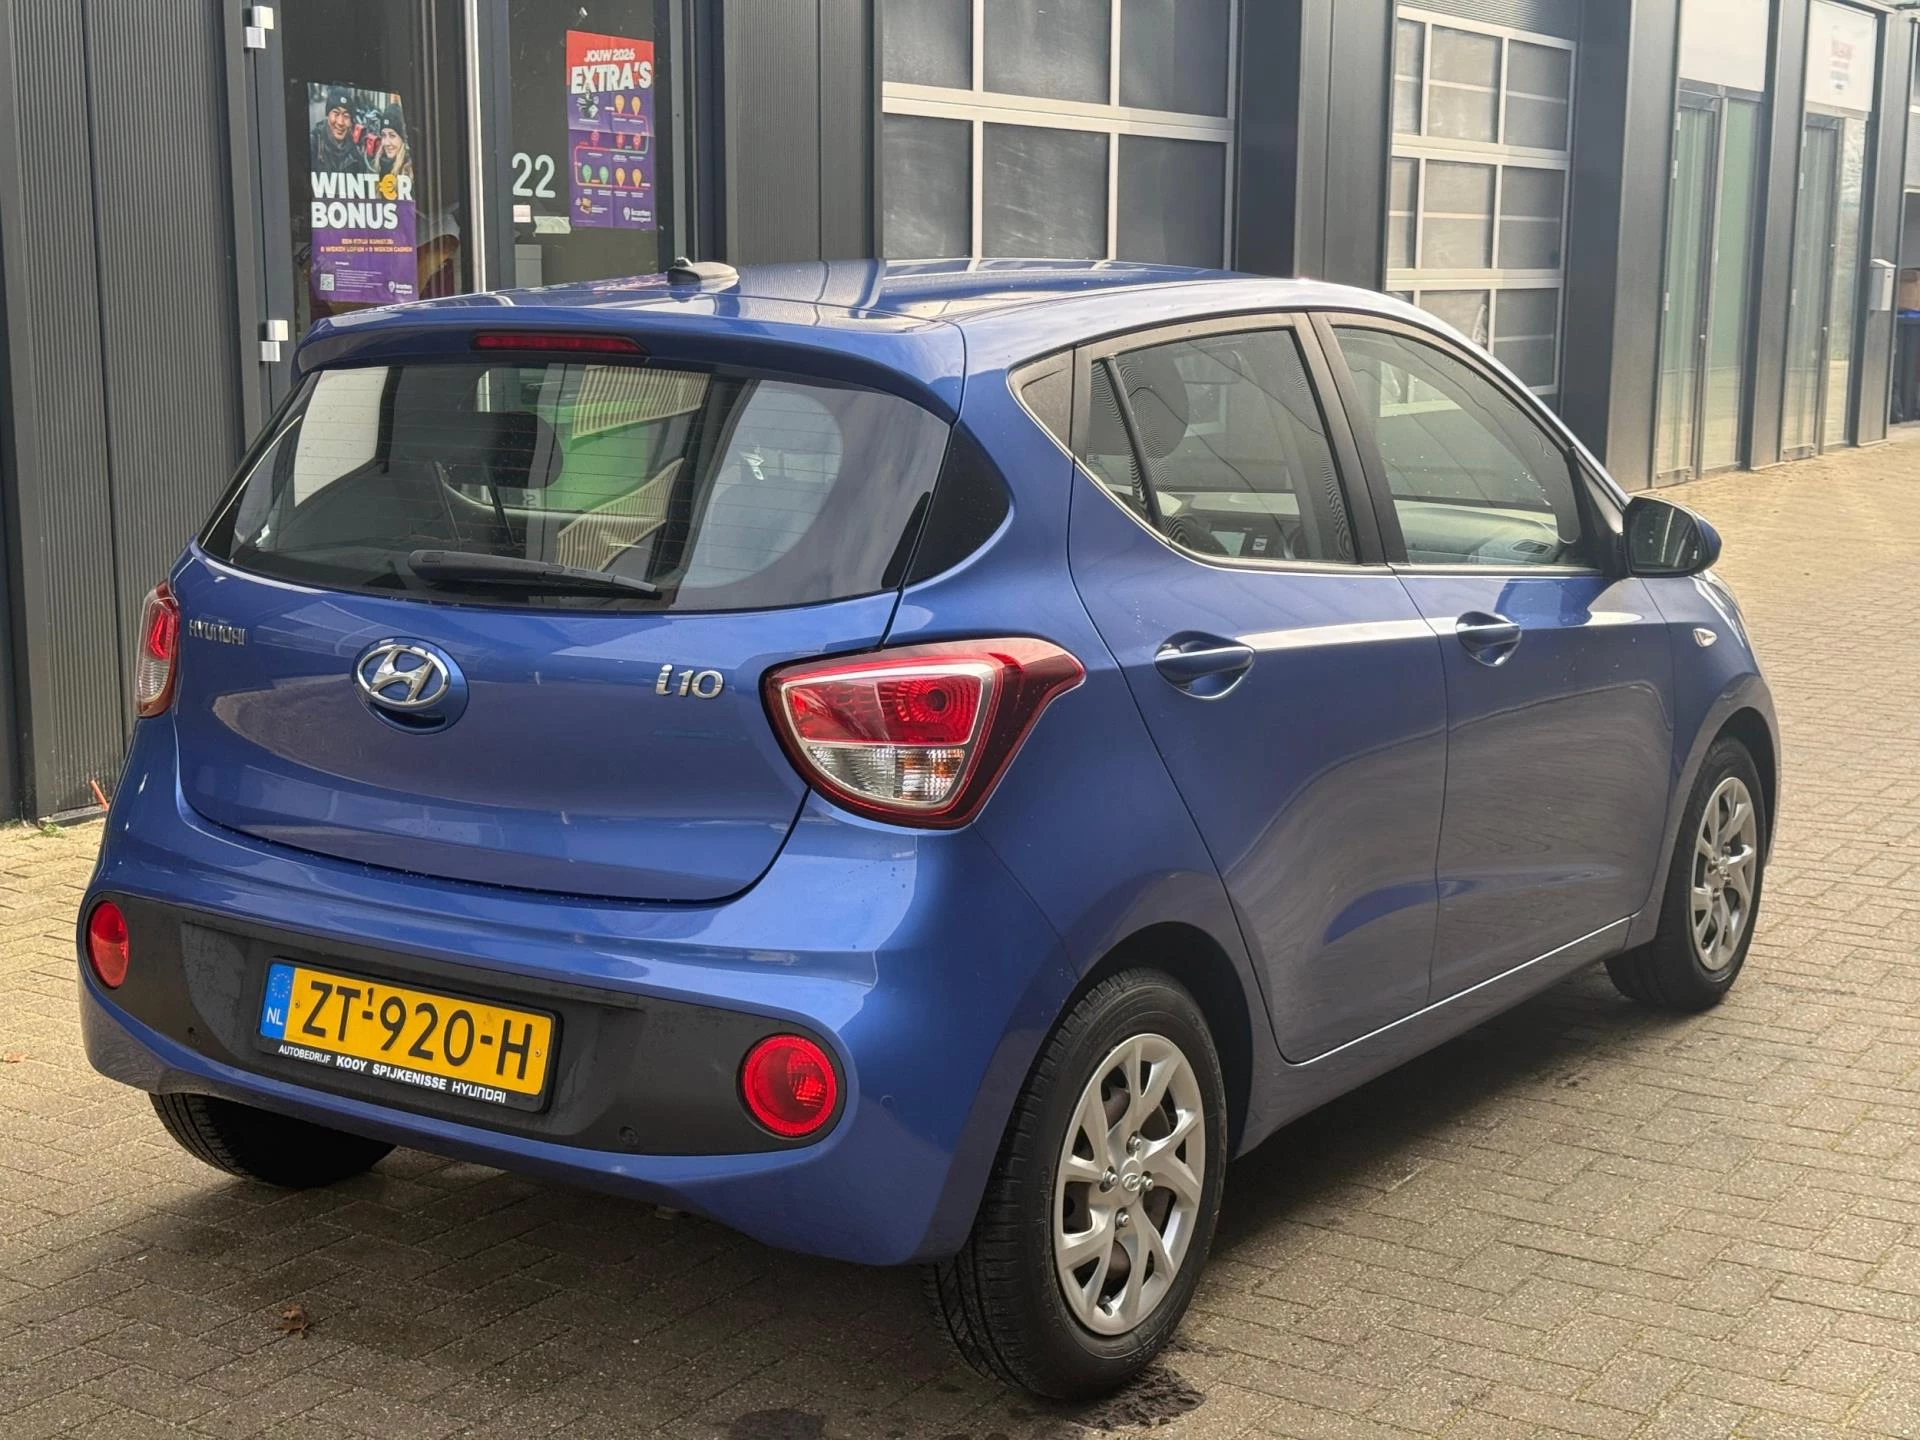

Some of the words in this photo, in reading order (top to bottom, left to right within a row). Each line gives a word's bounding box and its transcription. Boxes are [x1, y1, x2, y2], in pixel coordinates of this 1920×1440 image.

[584, 49, 612, 62] JOUW
[571, 61, 652, 94] EXTRA'S
[512, 152, 556, 198] 22
[311, 202, 398, 229] BONUS
[189, 620, 247, 646] HYUNDAI
[656, 664, 723, 699] i10
[266, 1007, 283, 1026] NL
[278, 1044, 331, 1064] AUTOBEDRIJF
[336, 1055, 368, 1072] KOOY
[372, 1063, 447, 1091] SPIJKENISSE
[451, 1081, 507, 1104] HYUNDAI
